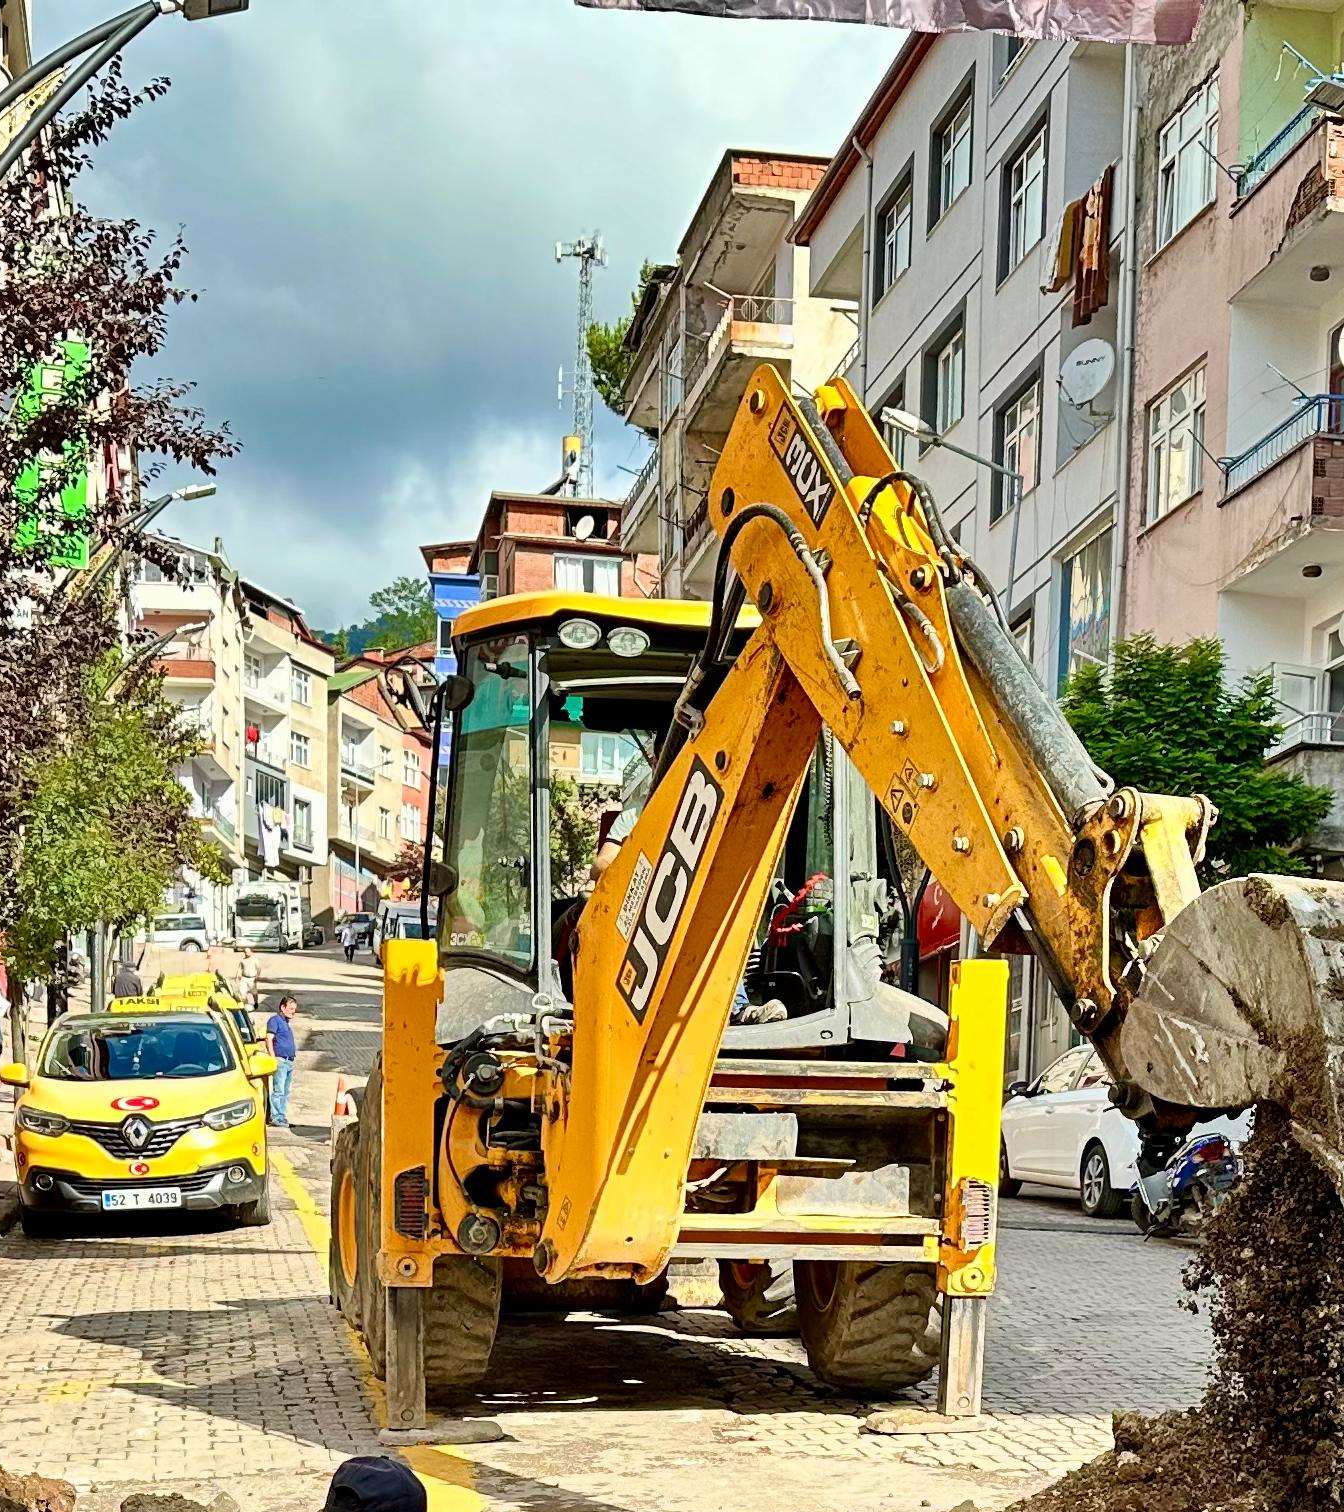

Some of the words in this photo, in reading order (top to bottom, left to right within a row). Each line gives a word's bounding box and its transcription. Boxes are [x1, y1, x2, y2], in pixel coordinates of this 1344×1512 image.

[785, 433, 831, 521] 3CX
[630, 769, 719, 1012] JCB
[110, 1194, 127, 1207] 52
[132, 1193, 140, 1206] T
[148, 1192, 178, 1205] 4039
